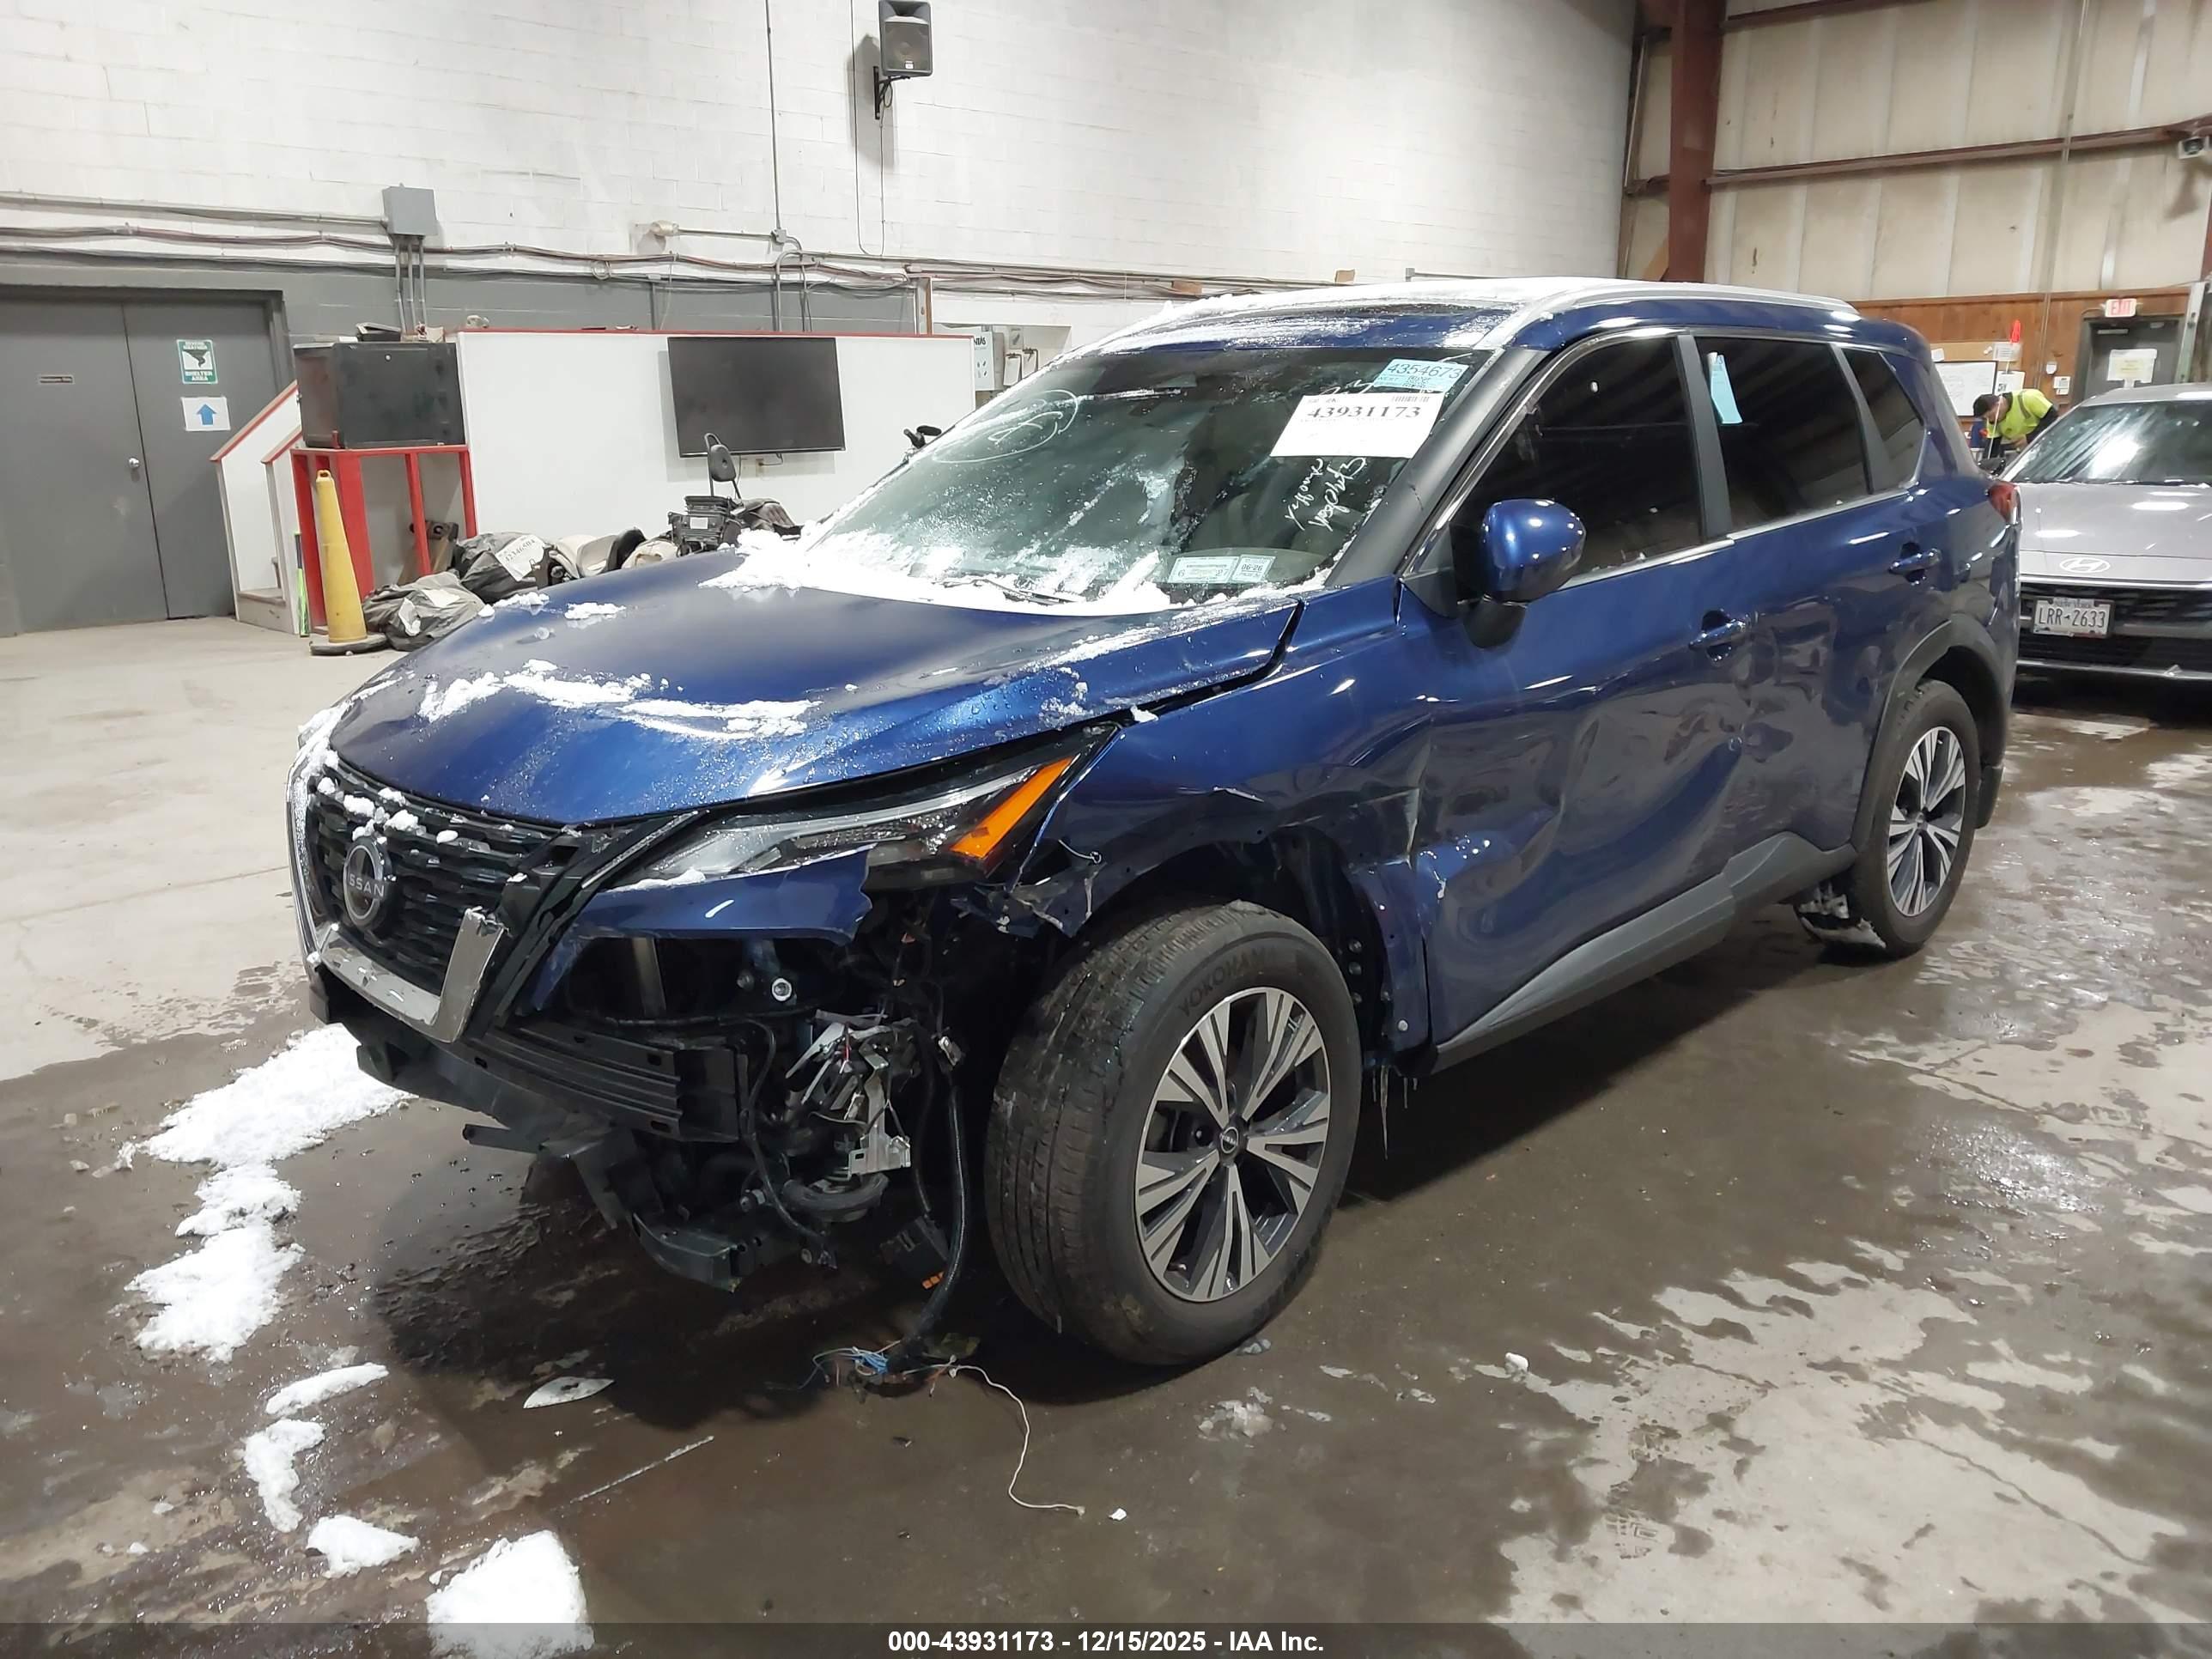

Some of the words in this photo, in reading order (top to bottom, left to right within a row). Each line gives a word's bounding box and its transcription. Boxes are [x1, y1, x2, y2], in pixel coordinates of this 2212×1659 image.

[2110, 300, 2134, 315] EXIT
[1387, 362, 1463, 380] 4354673
[1307, 406, 1421, 418] 43931173
